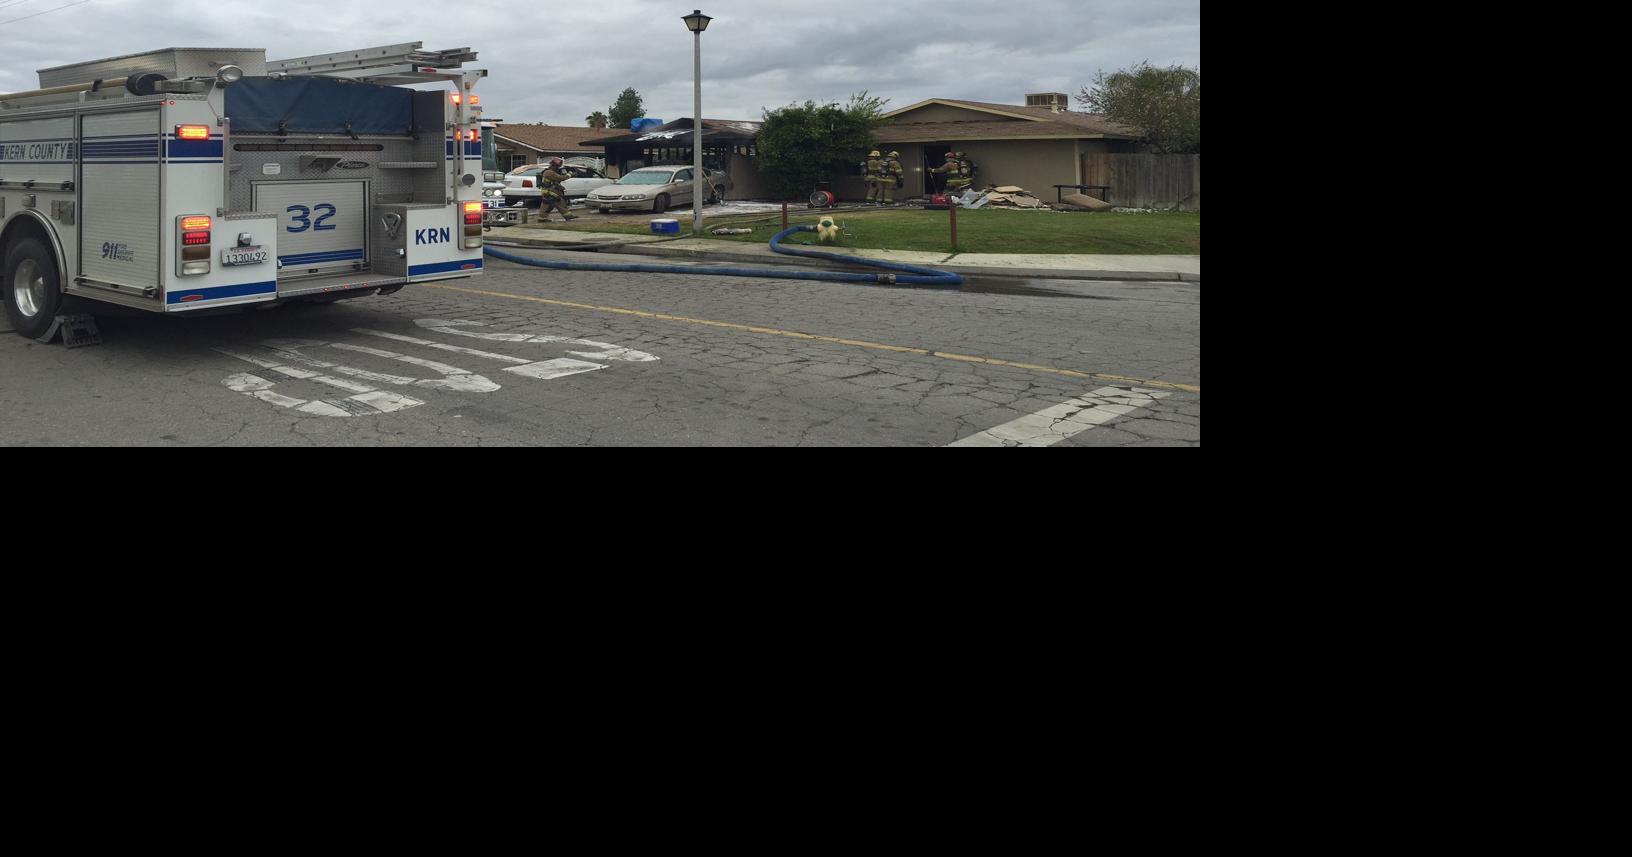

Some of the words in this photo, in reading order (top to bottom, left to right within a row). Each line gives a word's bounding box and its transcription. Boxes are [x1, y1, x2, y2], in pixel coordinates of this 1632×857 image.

[4, 144, 26, 160] KERN
[29, 143, 67, 160] COUNTY
[286, 203, 337, 233] 32
[415, 227, 450, 245] KRN
[102, 242, 118, 259] 911
